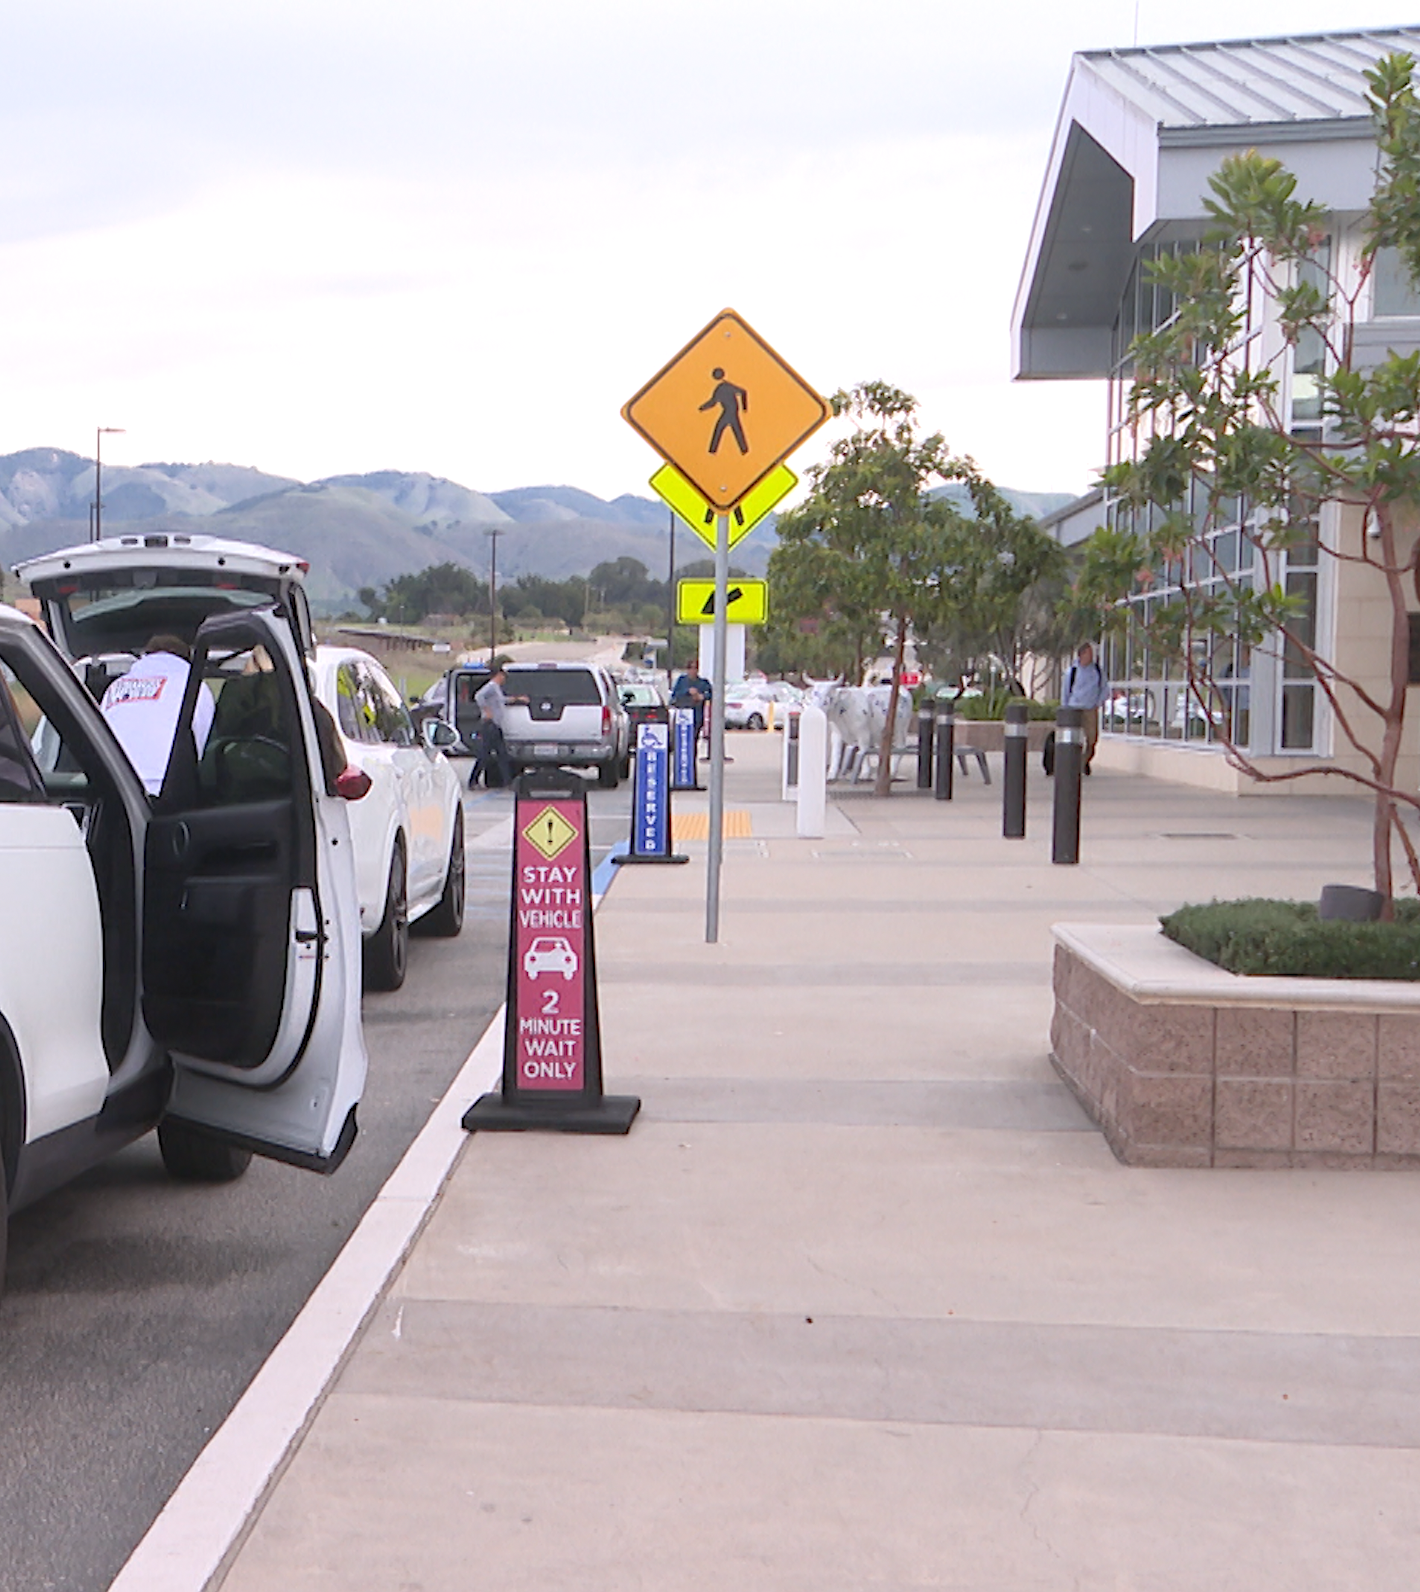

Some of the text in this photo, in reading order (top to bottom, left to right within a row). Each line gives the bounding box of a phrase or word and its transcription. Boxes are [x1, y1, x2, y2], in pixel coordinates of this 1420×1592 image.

[523, 866, 577, 883] STAY
[521, 888, 580, 904] WITH
[520, 910, 581, 928] VEHICLE
[541, 990, 559, 1014] 2
[520, 1018, 581, 1035] MINUTE
[524, 1039, 576, 1056] WAIT
[523, 1061, 576, 1079] ONLY
